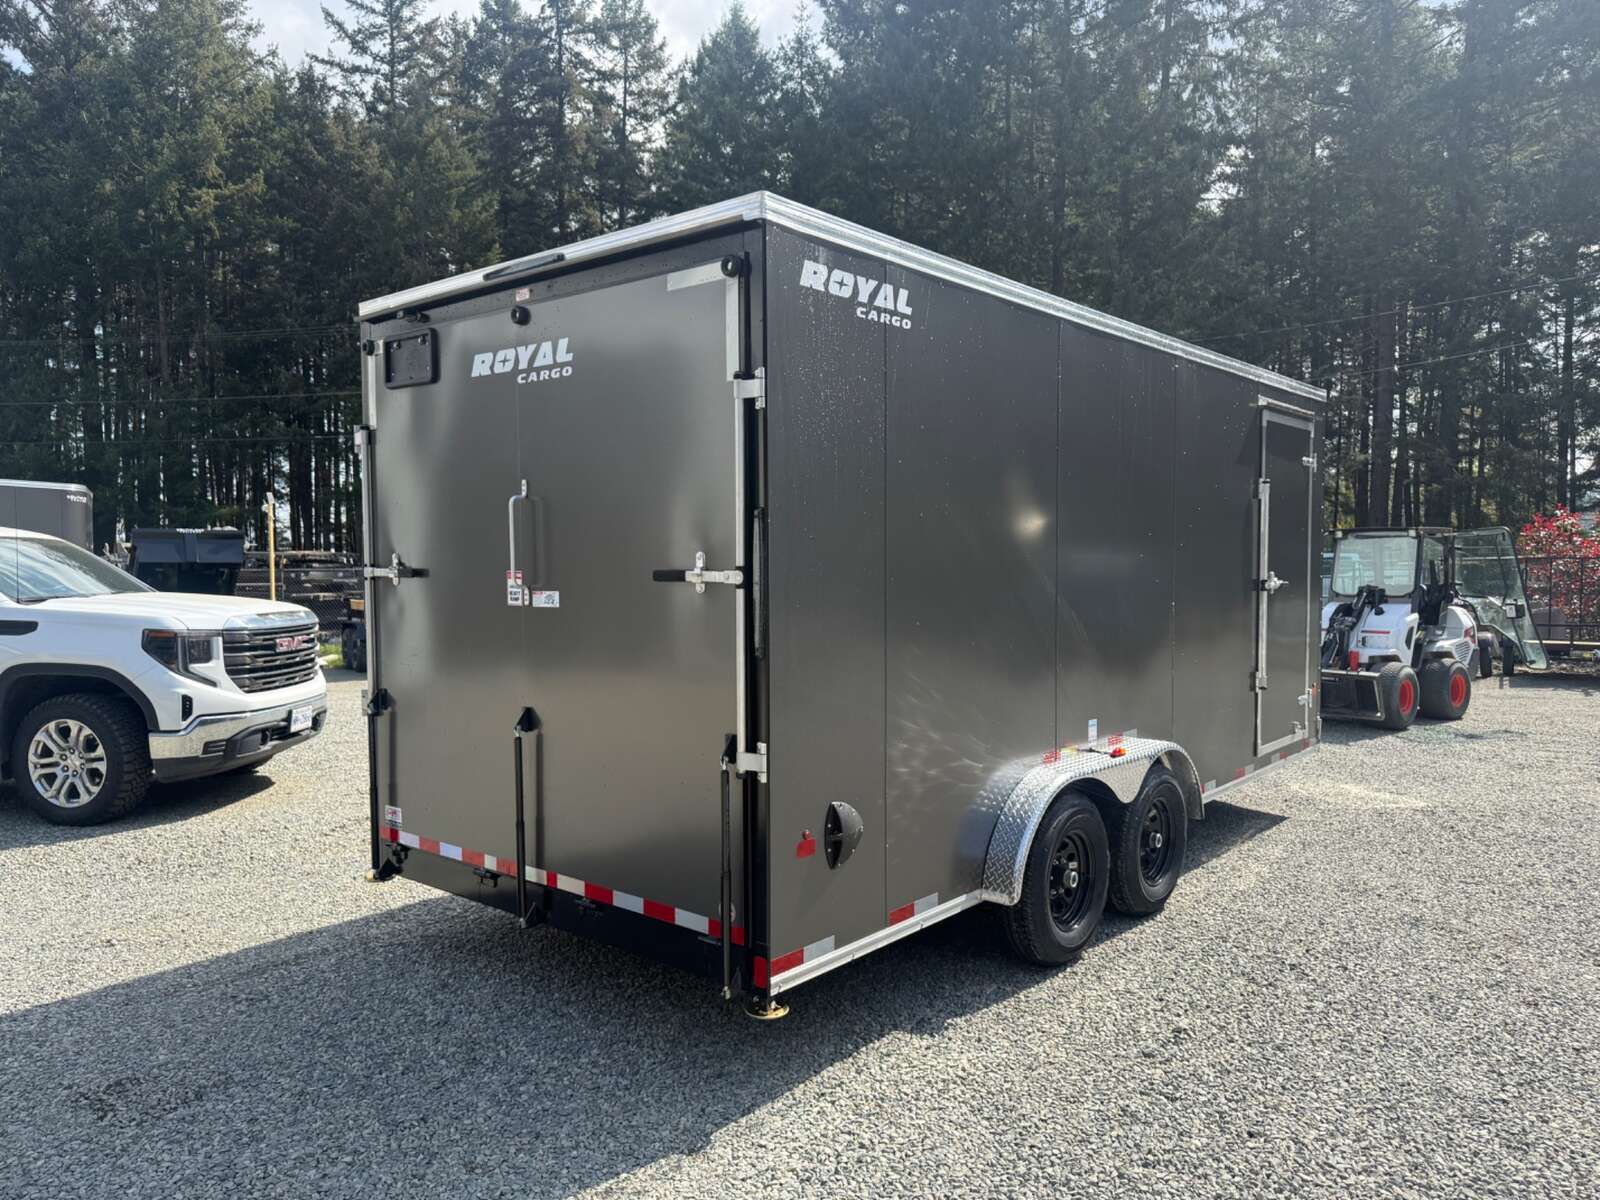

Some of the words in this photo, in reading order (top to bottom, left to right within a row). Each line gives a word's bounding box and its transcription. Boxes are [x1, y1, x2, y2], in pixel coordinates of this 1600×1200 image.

[800, 260, 912, 315] ROYAL
[856, 306, 912, 329] CARGO
[471, 337, 573, 377] ROYAL
[517, 366, 573, 384] CARGO
[276, 634, 315, 652] GMC
